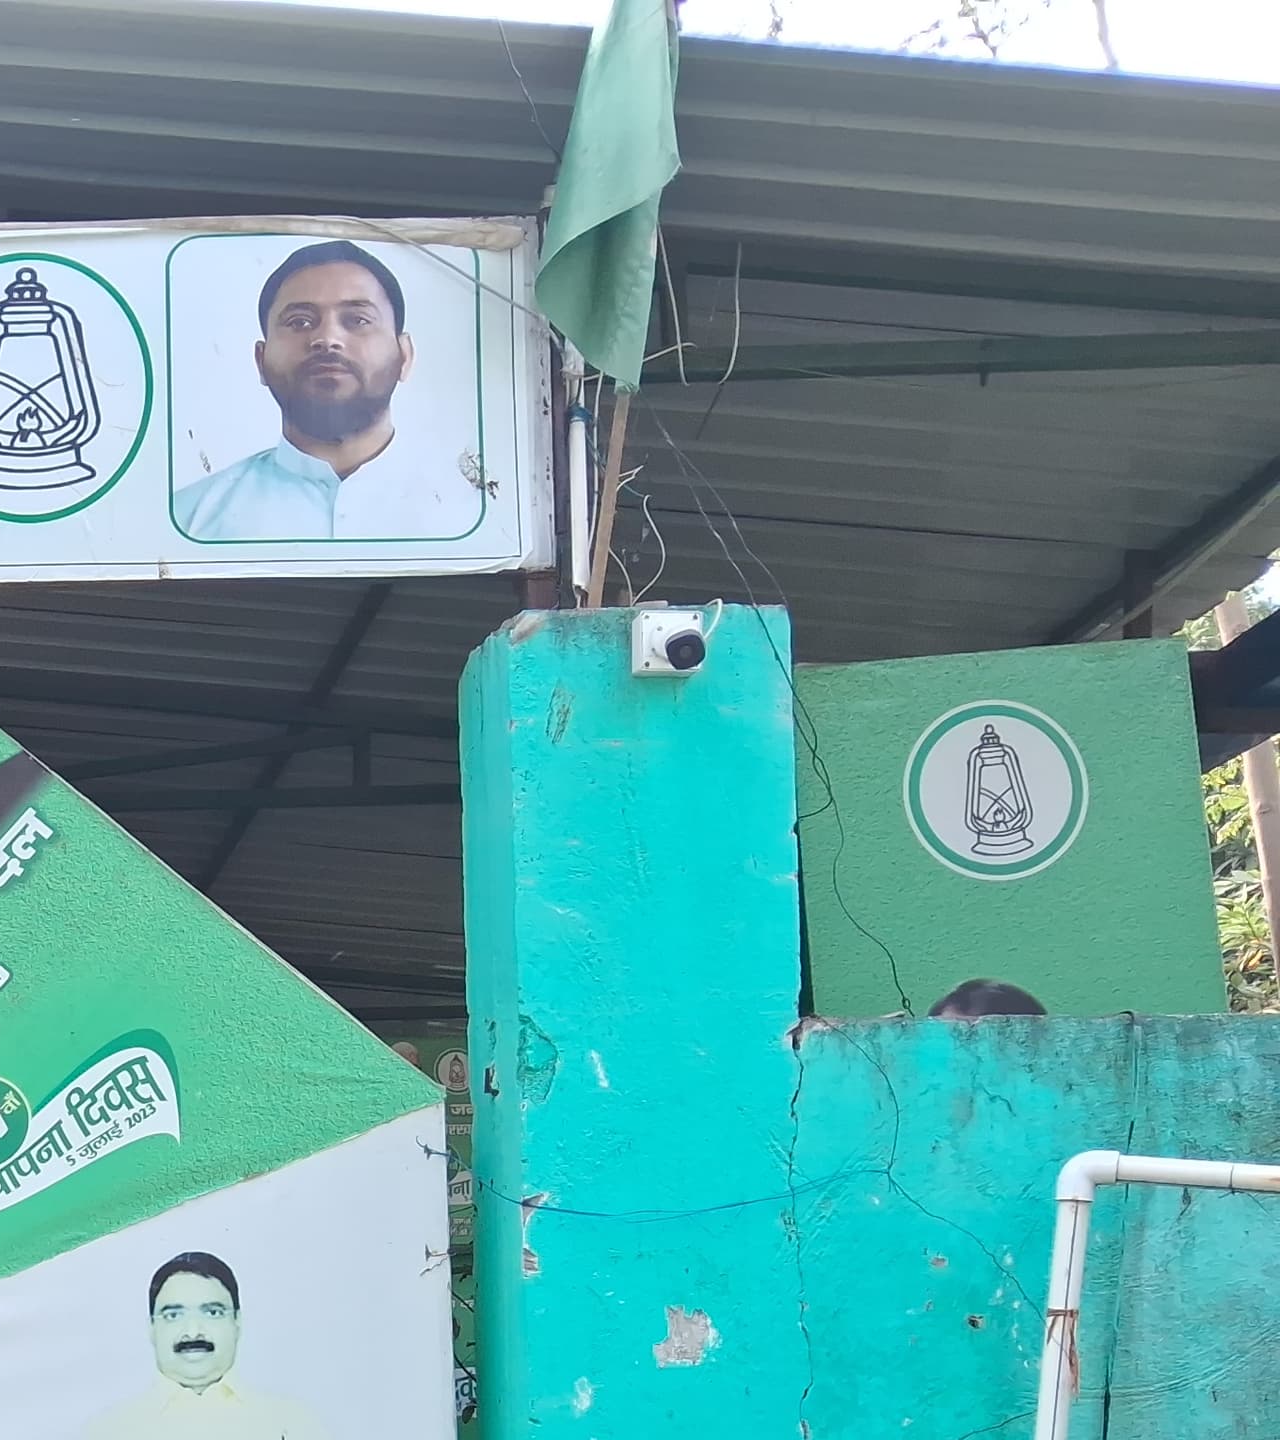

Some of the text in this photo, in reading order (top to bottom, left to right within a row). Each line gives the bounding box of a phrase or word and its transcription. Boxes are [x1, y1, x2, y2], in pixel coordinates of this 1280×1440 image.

[64, 1055, 168, 1137] दिवस
[65, 1102, 158, 1167] 5 जुलाई 2023
